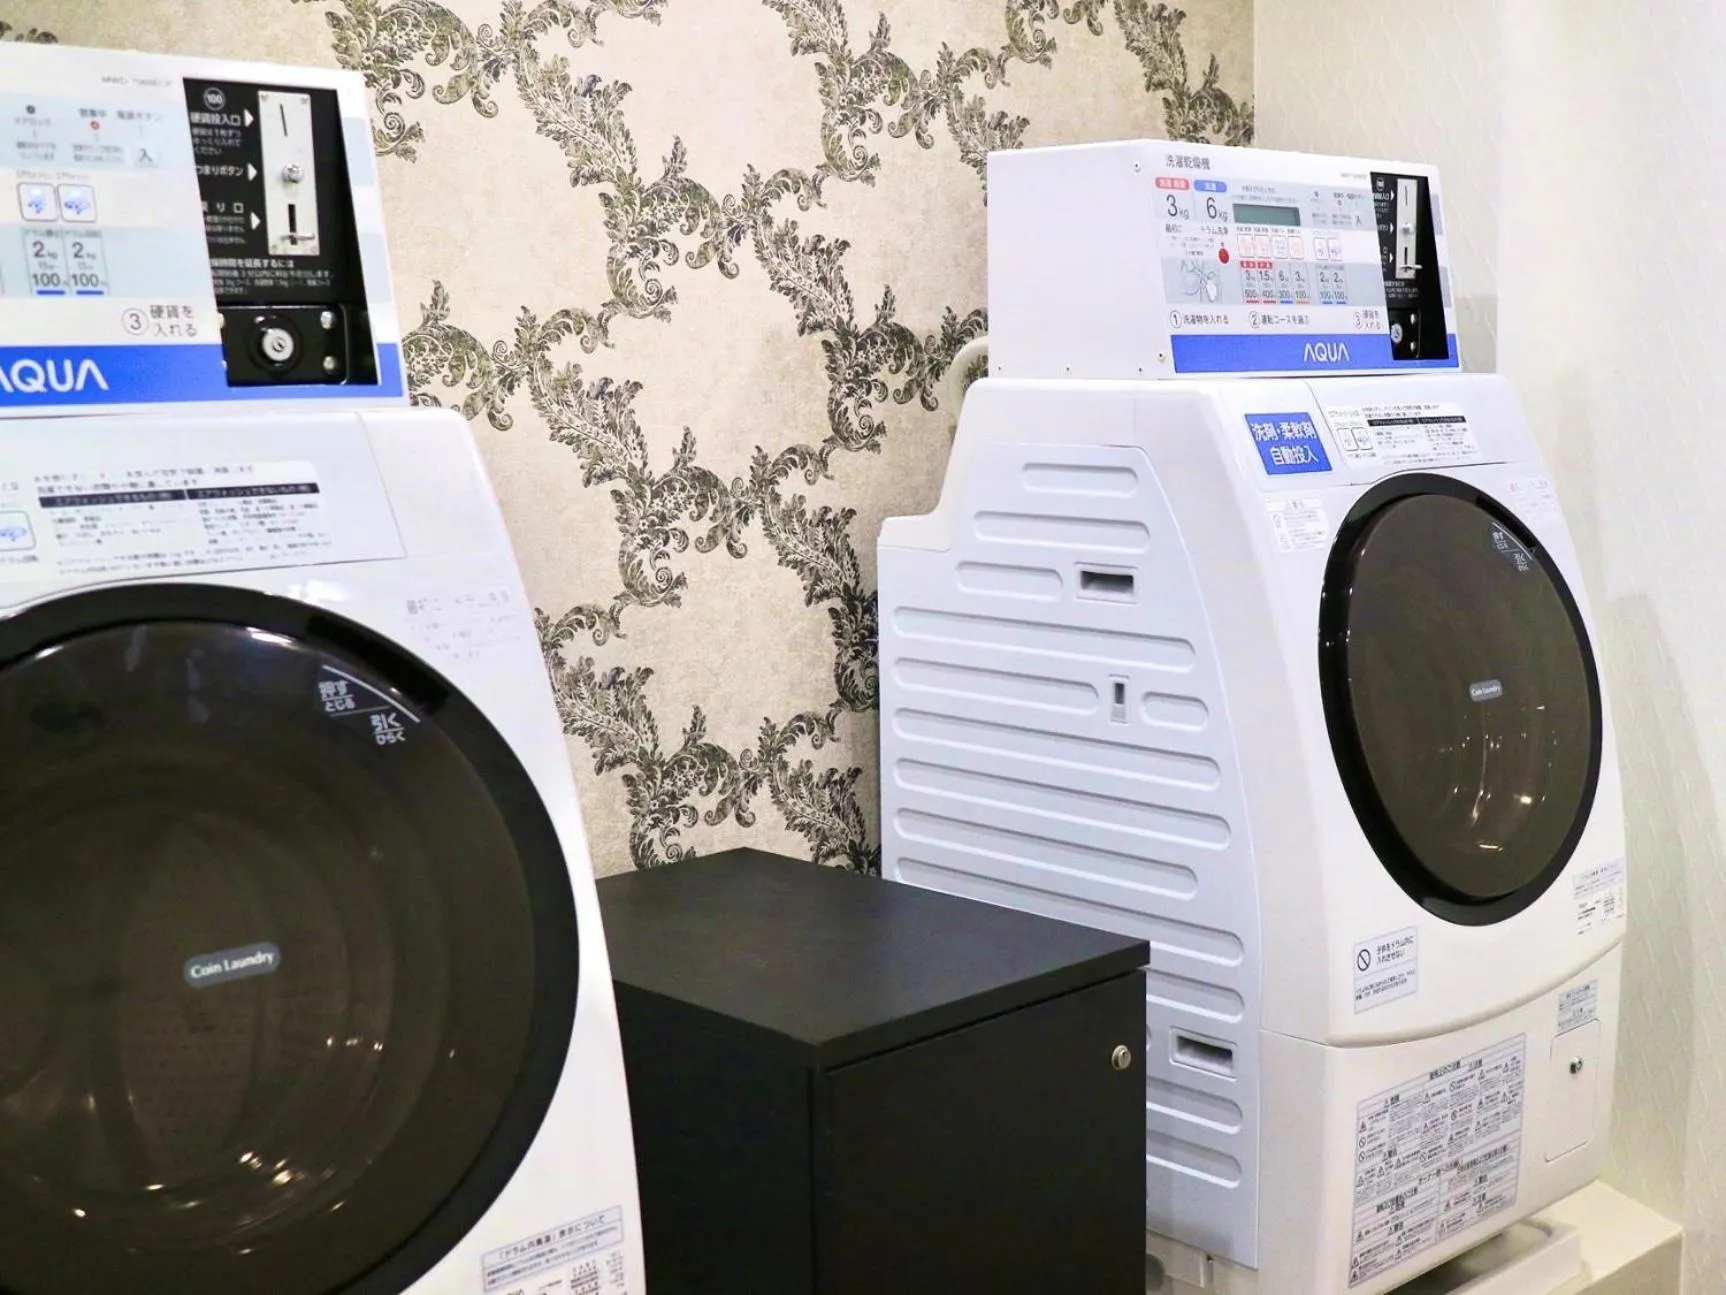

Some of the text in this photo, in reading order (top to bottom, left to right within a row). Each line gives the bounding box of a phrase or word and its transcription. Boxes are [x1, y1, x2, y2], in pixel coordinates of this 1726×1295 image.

[138, 148, 153, 163] 入
[154, 322, 197, 338] 入れる
[1303, 342, 1350, 363] AQUA
[1269, 445, 1320, 466] 自動投入
[190, 951, 274, 979] Coin Laundry
